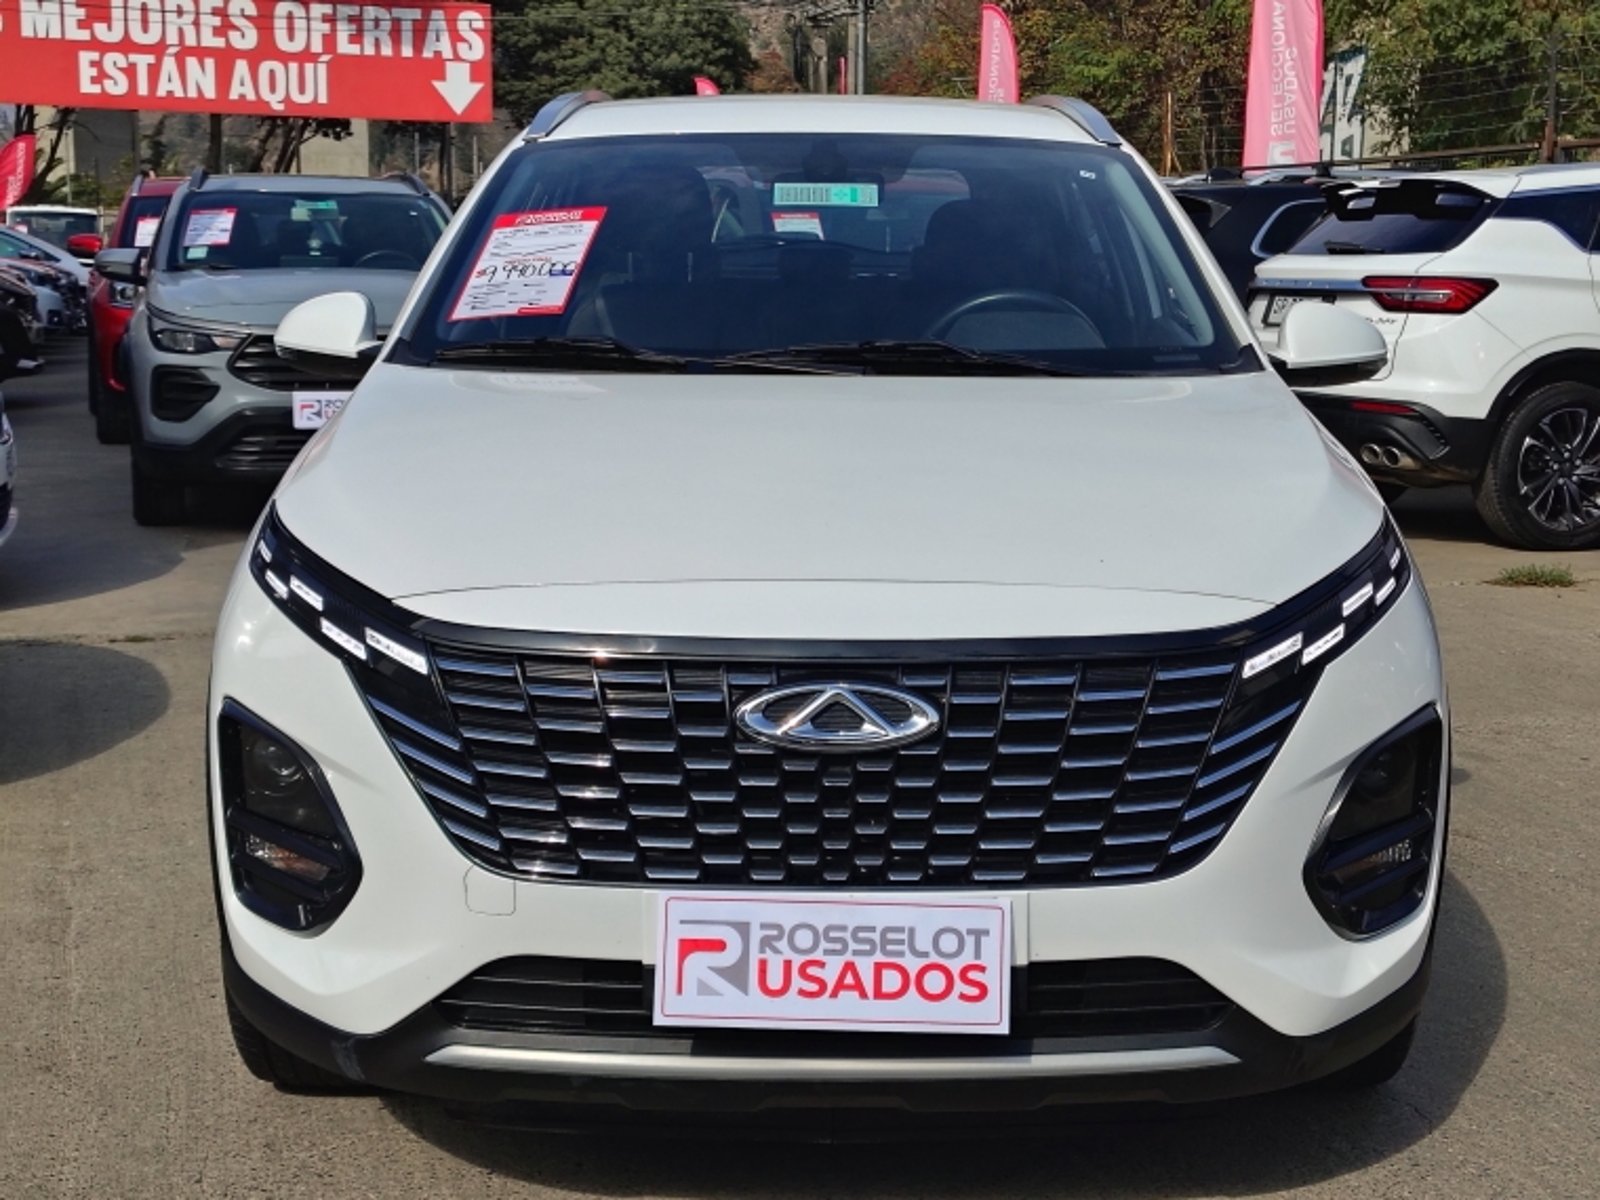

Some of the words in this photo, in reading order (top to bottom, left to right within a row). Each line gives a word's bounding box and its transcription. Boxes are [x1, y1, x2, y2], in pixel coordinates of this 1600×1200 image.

[20, 0, 259, 50] MEJORES
[273, 2, 486, 62] OFERTAS
[78, 46, 217, 100] ESTÁN
[229, 54, 333, 111] AQUÍ
[758, 921, 991, 961] ROSSELOT
[757, 957, 989, 1004] USADOS
